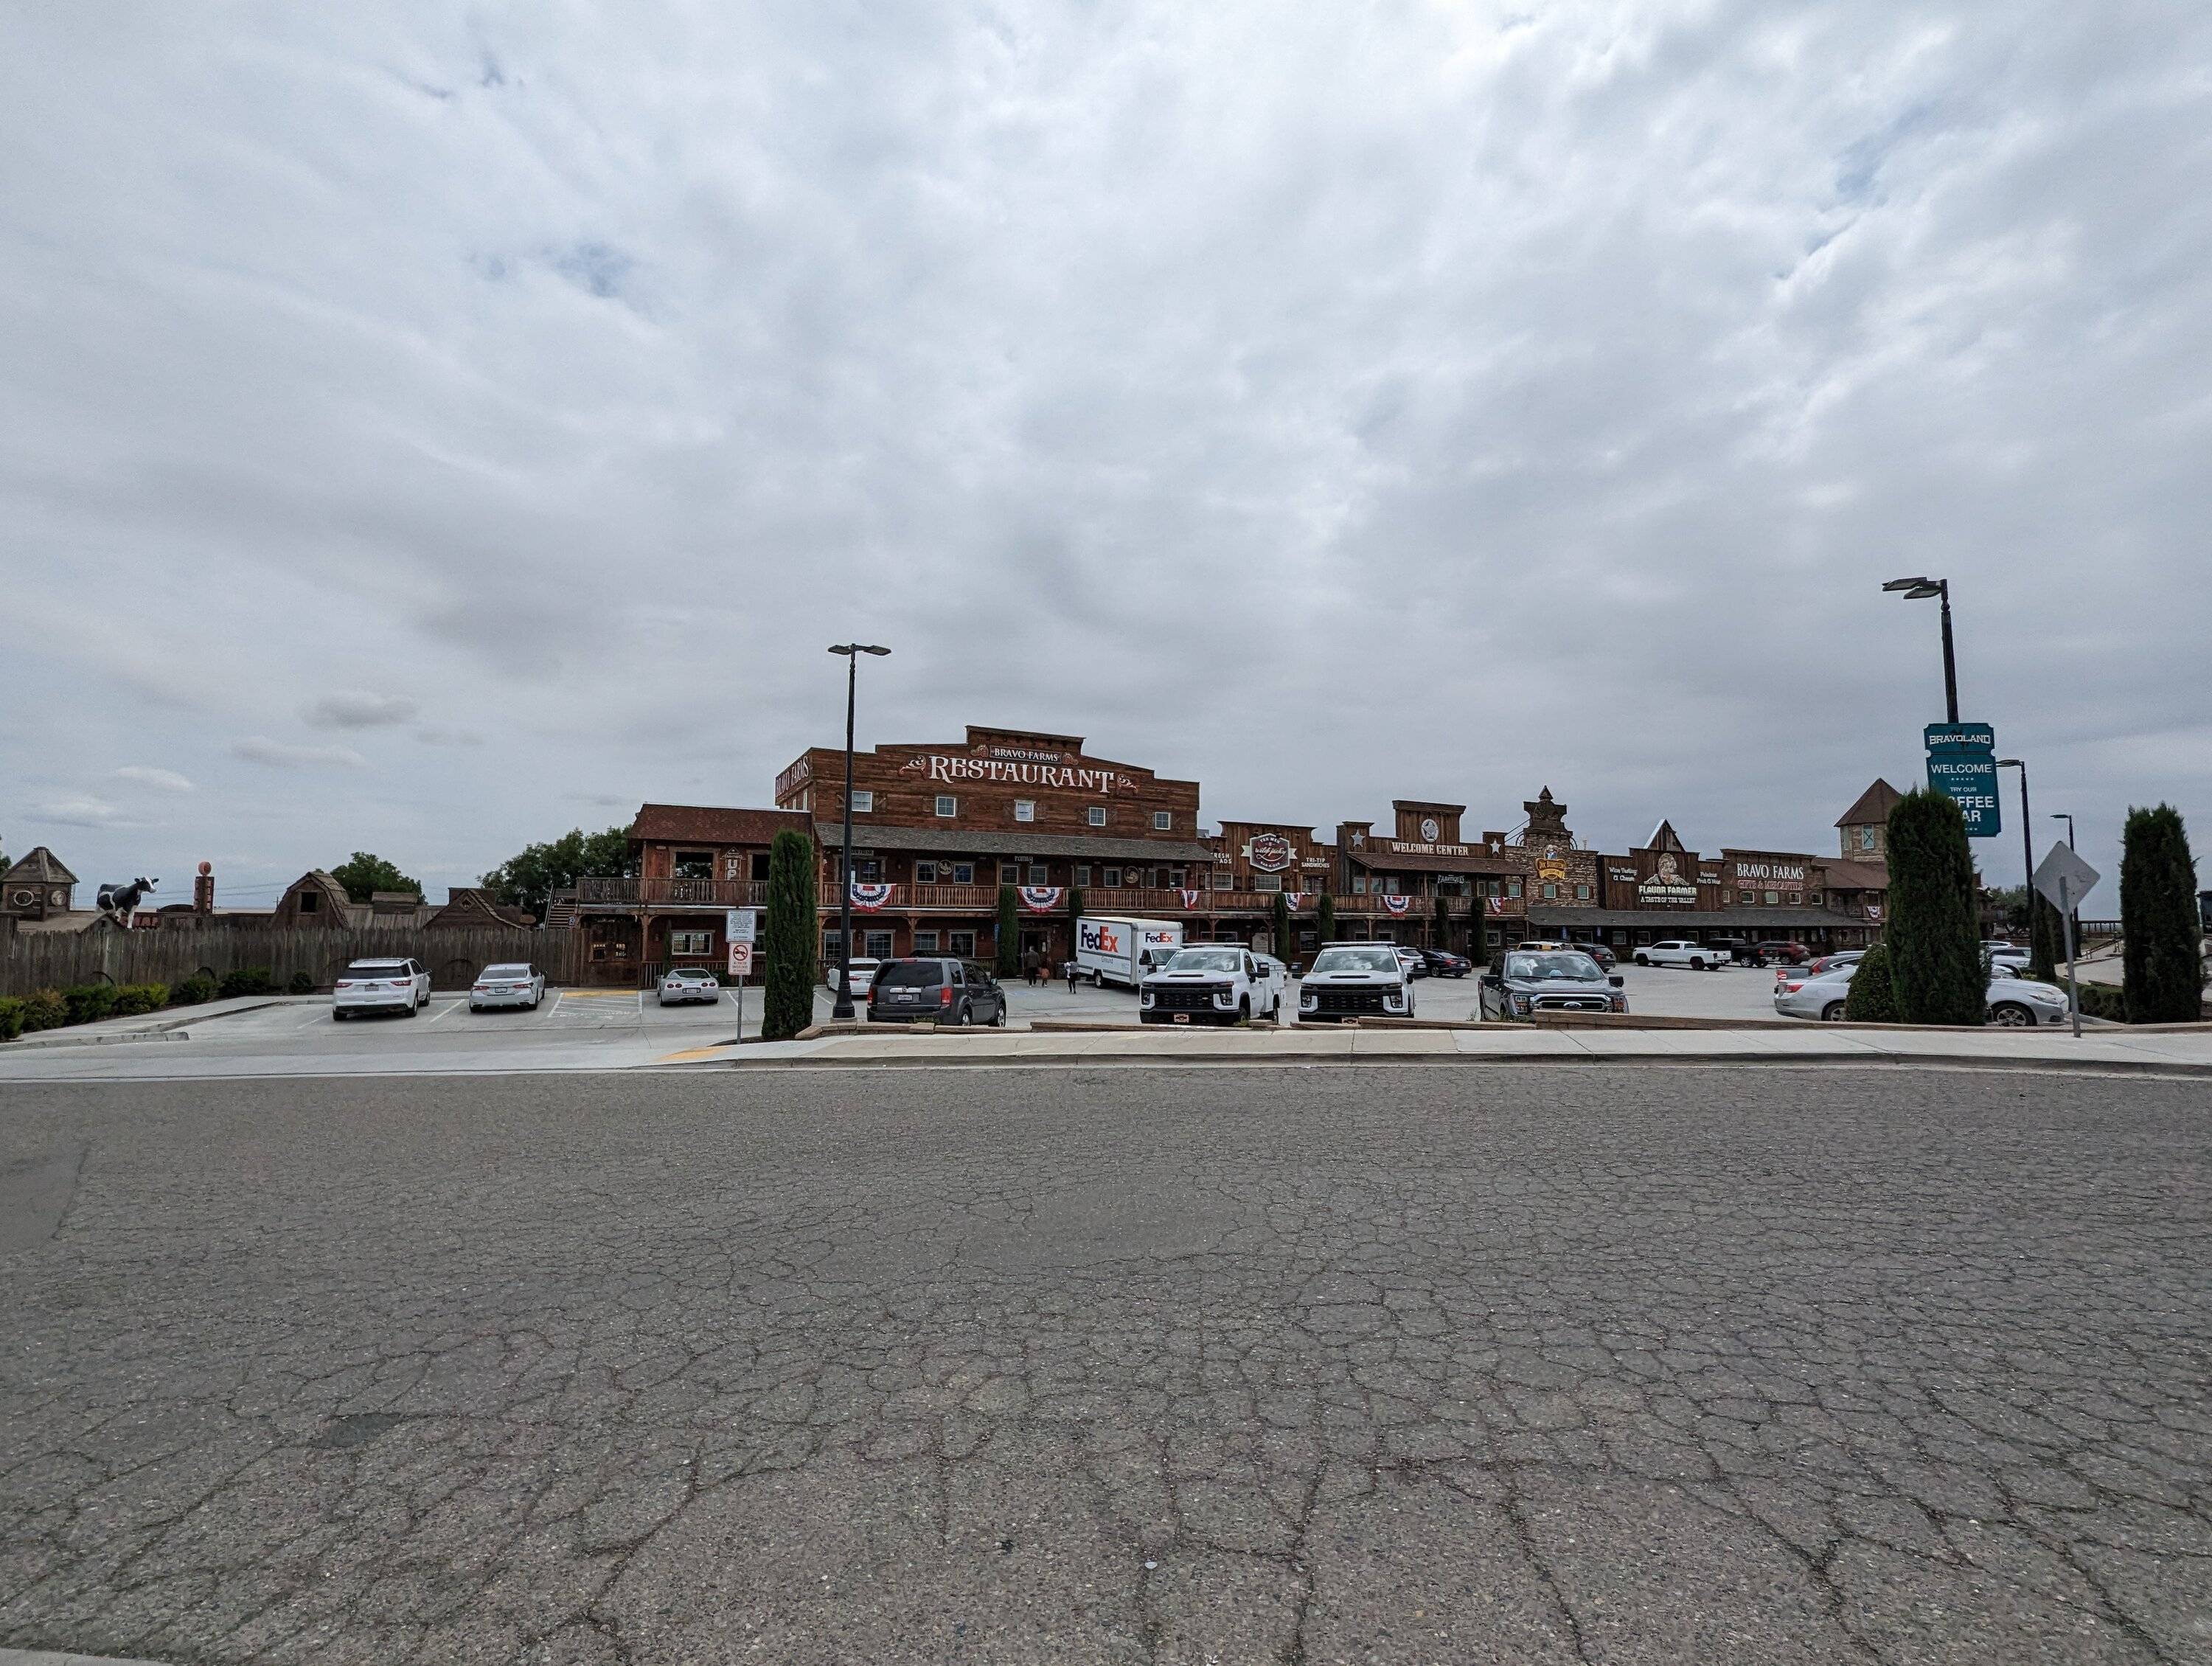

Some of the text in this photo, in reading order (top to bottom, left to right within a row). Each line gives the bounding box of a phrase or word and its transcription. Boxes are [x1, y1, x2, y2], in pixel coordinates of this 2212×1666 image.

[1928, 735, 1991, 745] BRAVOLAND
[995, 747, 1058, 762] BRAVO FARMS
[928, 755, 1115, 794] RESTAURANT
[1930, 763, 1992, 774] WELCOME
[1961, 810, 1981, 822] AR
[1391, 841, 1470, 856] WELCOME CENTER
[1736, 863, 1804, 880] BRAVO FARMS
[1667, 886, 1697, 895] FARMER
[1081, 923, 1119, 954] FedEx
[1145, 932, 1173, 943] FedEx
